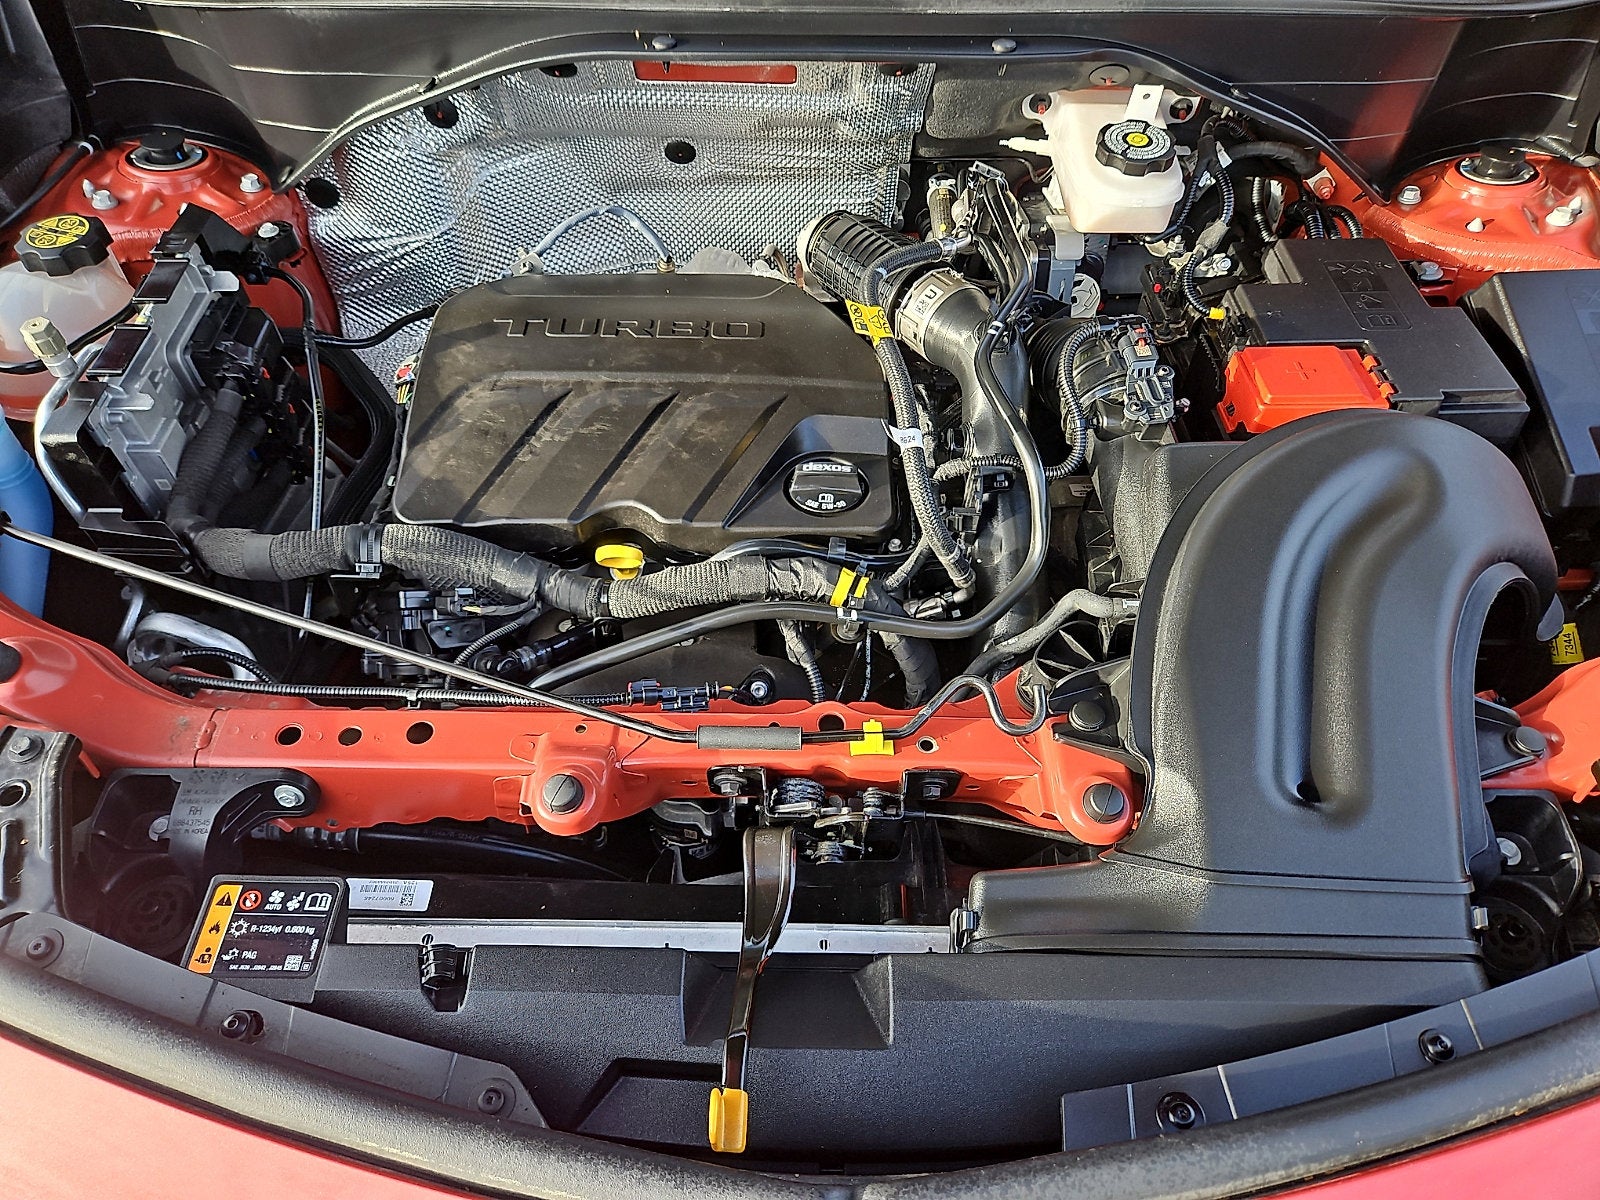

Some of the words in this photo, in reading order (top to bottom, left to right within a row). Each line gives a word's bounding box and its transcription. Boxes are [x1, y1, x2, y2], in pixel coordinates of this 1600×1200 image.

[492, 318, 766, 340] TURBO
[802, 462, 852, 473] dexos
[1562, 632, 1575, 656] 7344
[188, 805, 203, 816] RH
[250, 924, 282, 935] R-1234yf
[305, 926, 316, 936] kg
[241, 950, 257, 959] PAG
